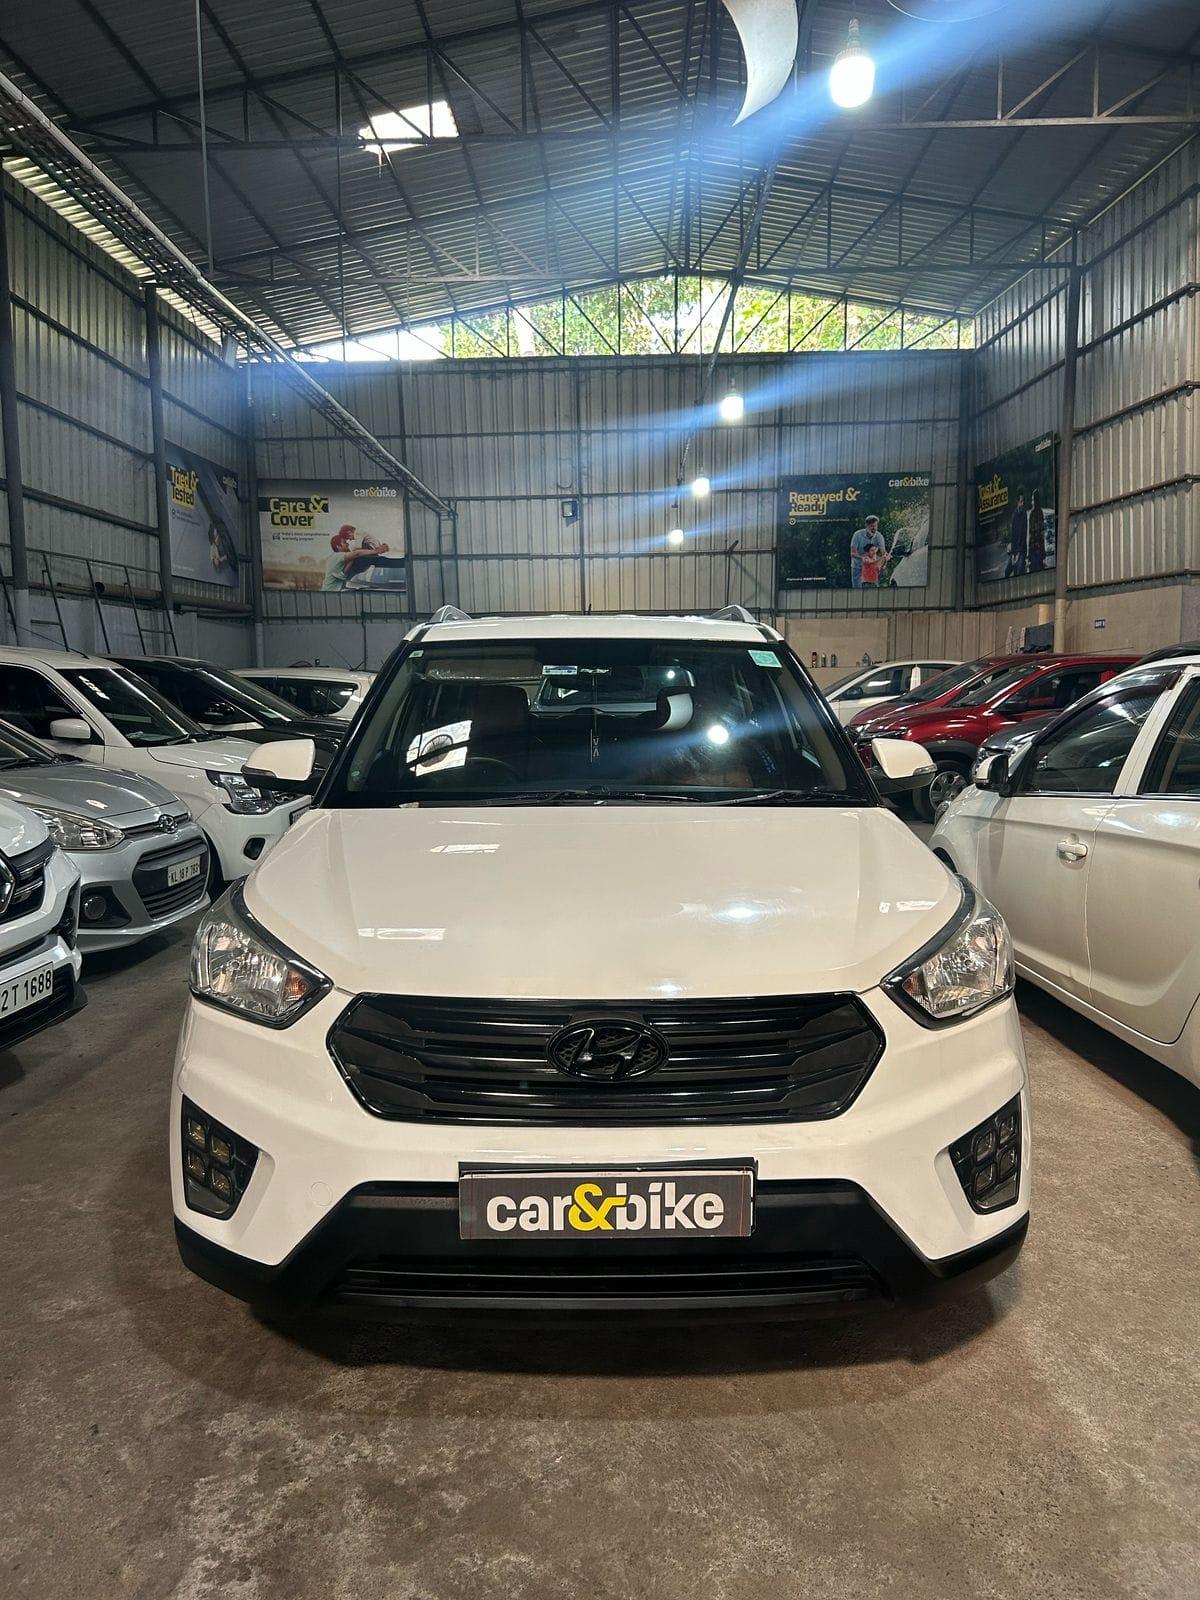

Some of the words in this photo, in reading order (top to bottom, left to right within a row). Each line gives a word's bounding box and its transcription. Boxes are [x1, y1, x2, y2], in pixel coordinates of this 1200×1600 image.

[170, 465, 190, 489] Tried
[191, 470, 199, 490] &
[888, 477, 929, 487] car&bike
[171, 483, 195, 505] Tested
[353, 486, 397, 498] car&bike
[789, 490, 843, 503] Renewed
[845, 487, 860, 501] &
[269, 498, 306, 513] Care
[309, 494, 329, 513] &
[790, 502, 826, 515] Ready
[270, 511, 314, 526] Cover
[12, 983, 19, 1006] T
[24, 970, 52, 1000] 1688
[486, 1182, 725, 1232] car&bike
